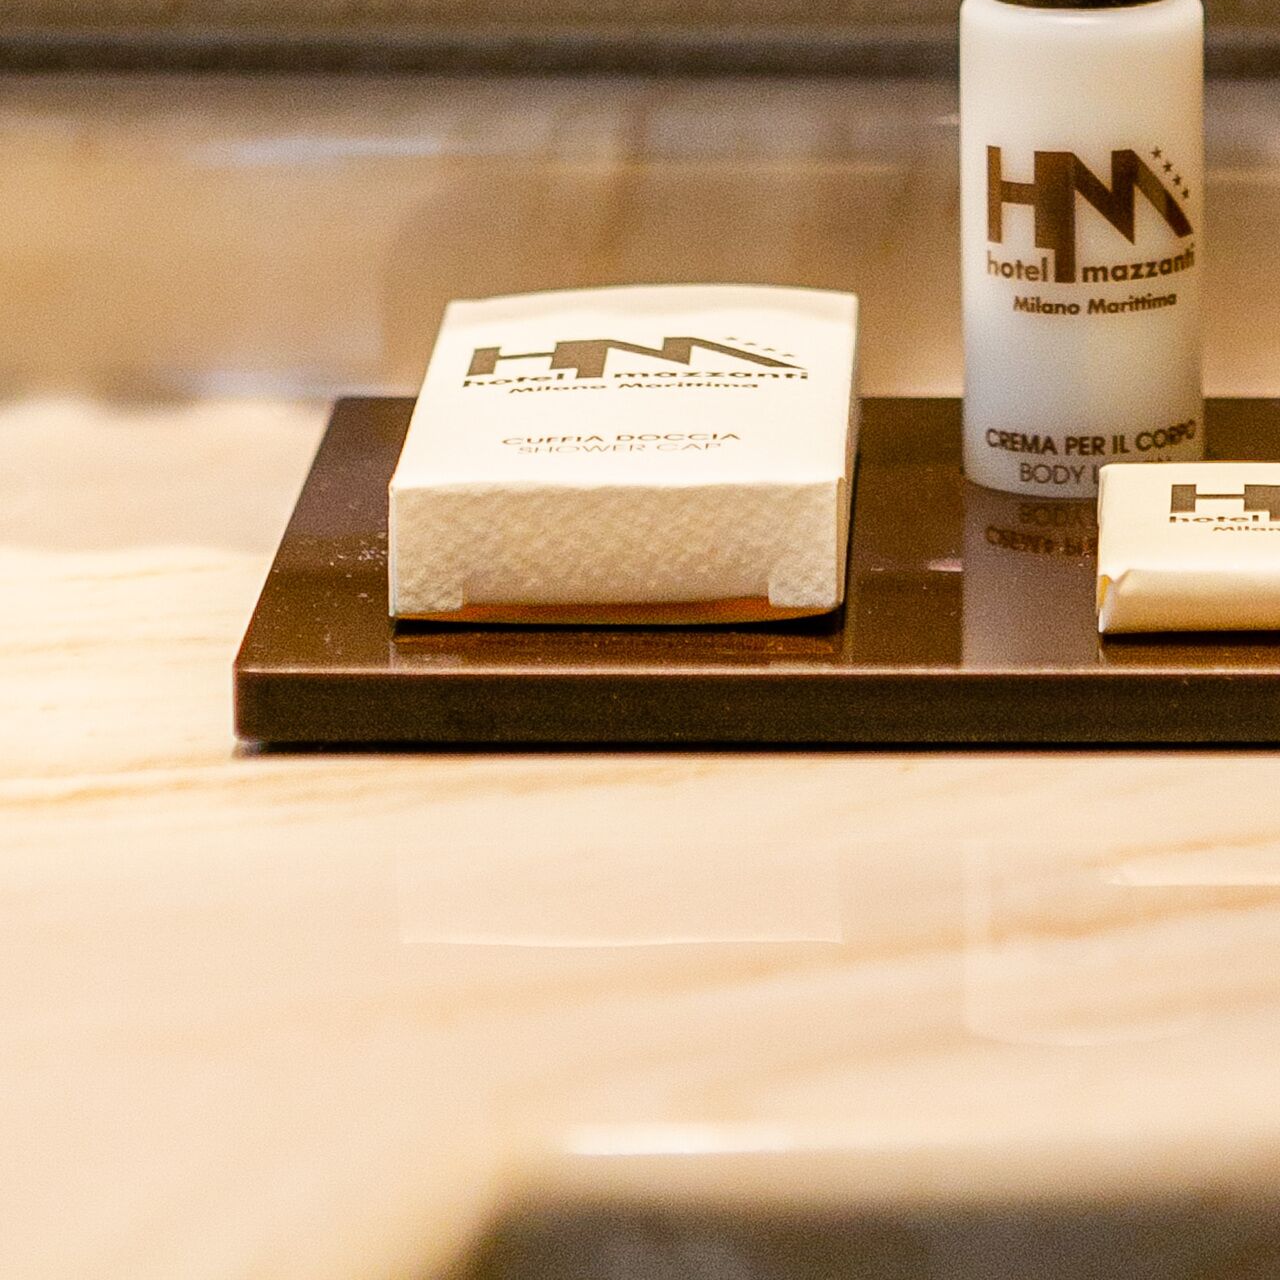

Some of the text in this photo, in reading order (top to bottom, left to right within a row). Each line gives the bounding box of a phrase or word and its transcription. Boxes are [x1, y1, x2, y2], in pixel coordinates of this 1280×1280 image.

[986, 244, 1195, 283] hotel mazzanti
[1013, 291, 1177, 315] Milano Marittima
[462, 371, 809, 387] hotel mazzanti
[508, 384, 607, 394] Milano
[502, 432, 741, 445] CUFFIA DOCCIA
[986, 419, 1196, 456] CREMA PER IL CORPO
[518, 442, 722, 455] SHOWER CAP
[1020, 462, 1086, 485] BODY
[1169, 514, 1260, 524] hotel
